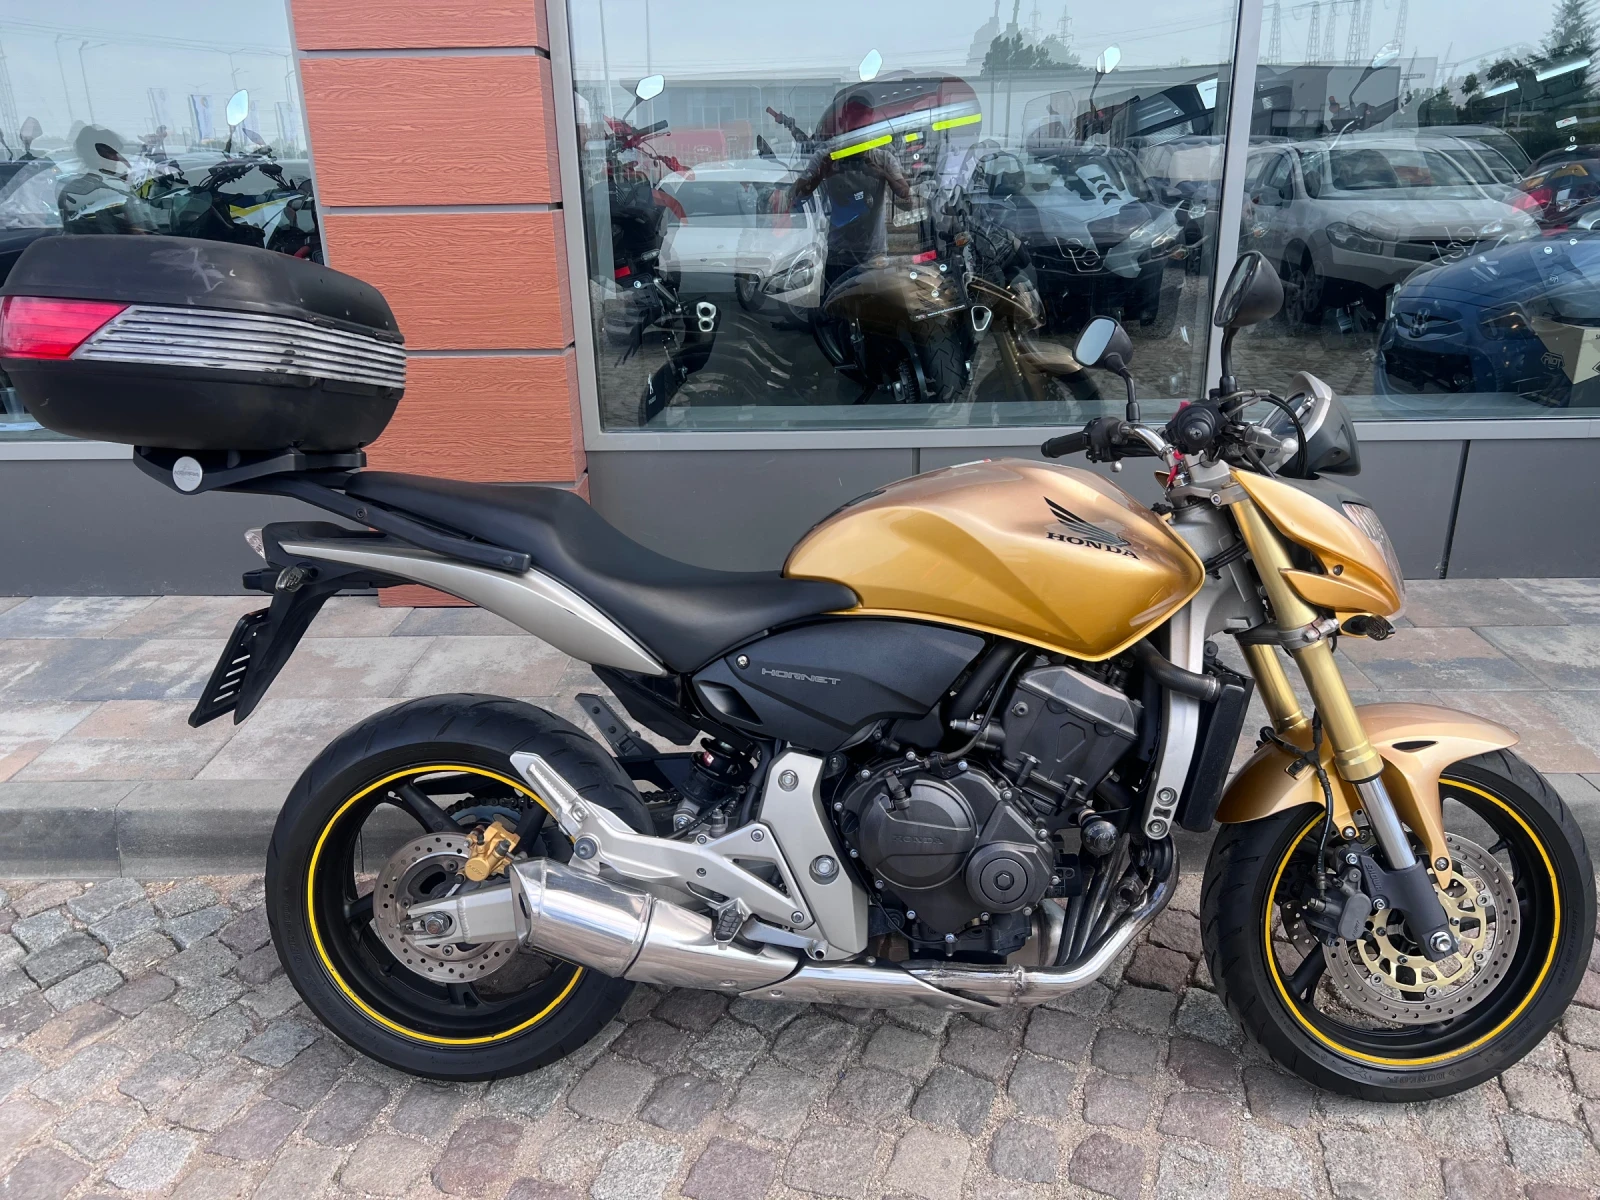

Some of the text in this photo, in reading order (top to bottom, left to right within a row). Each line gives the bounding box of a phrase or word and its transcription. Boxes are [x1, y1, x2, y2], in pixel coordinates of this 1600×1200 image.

[1046, 532, 1140, 560] HONDA
[761, 667, 841, 685] HORNET
[891, 834, 944, 846] HONDA
[1365, 863, 1383, 891] SHOWA
[1388, 1071, 1445, 1084] DUNLOP
